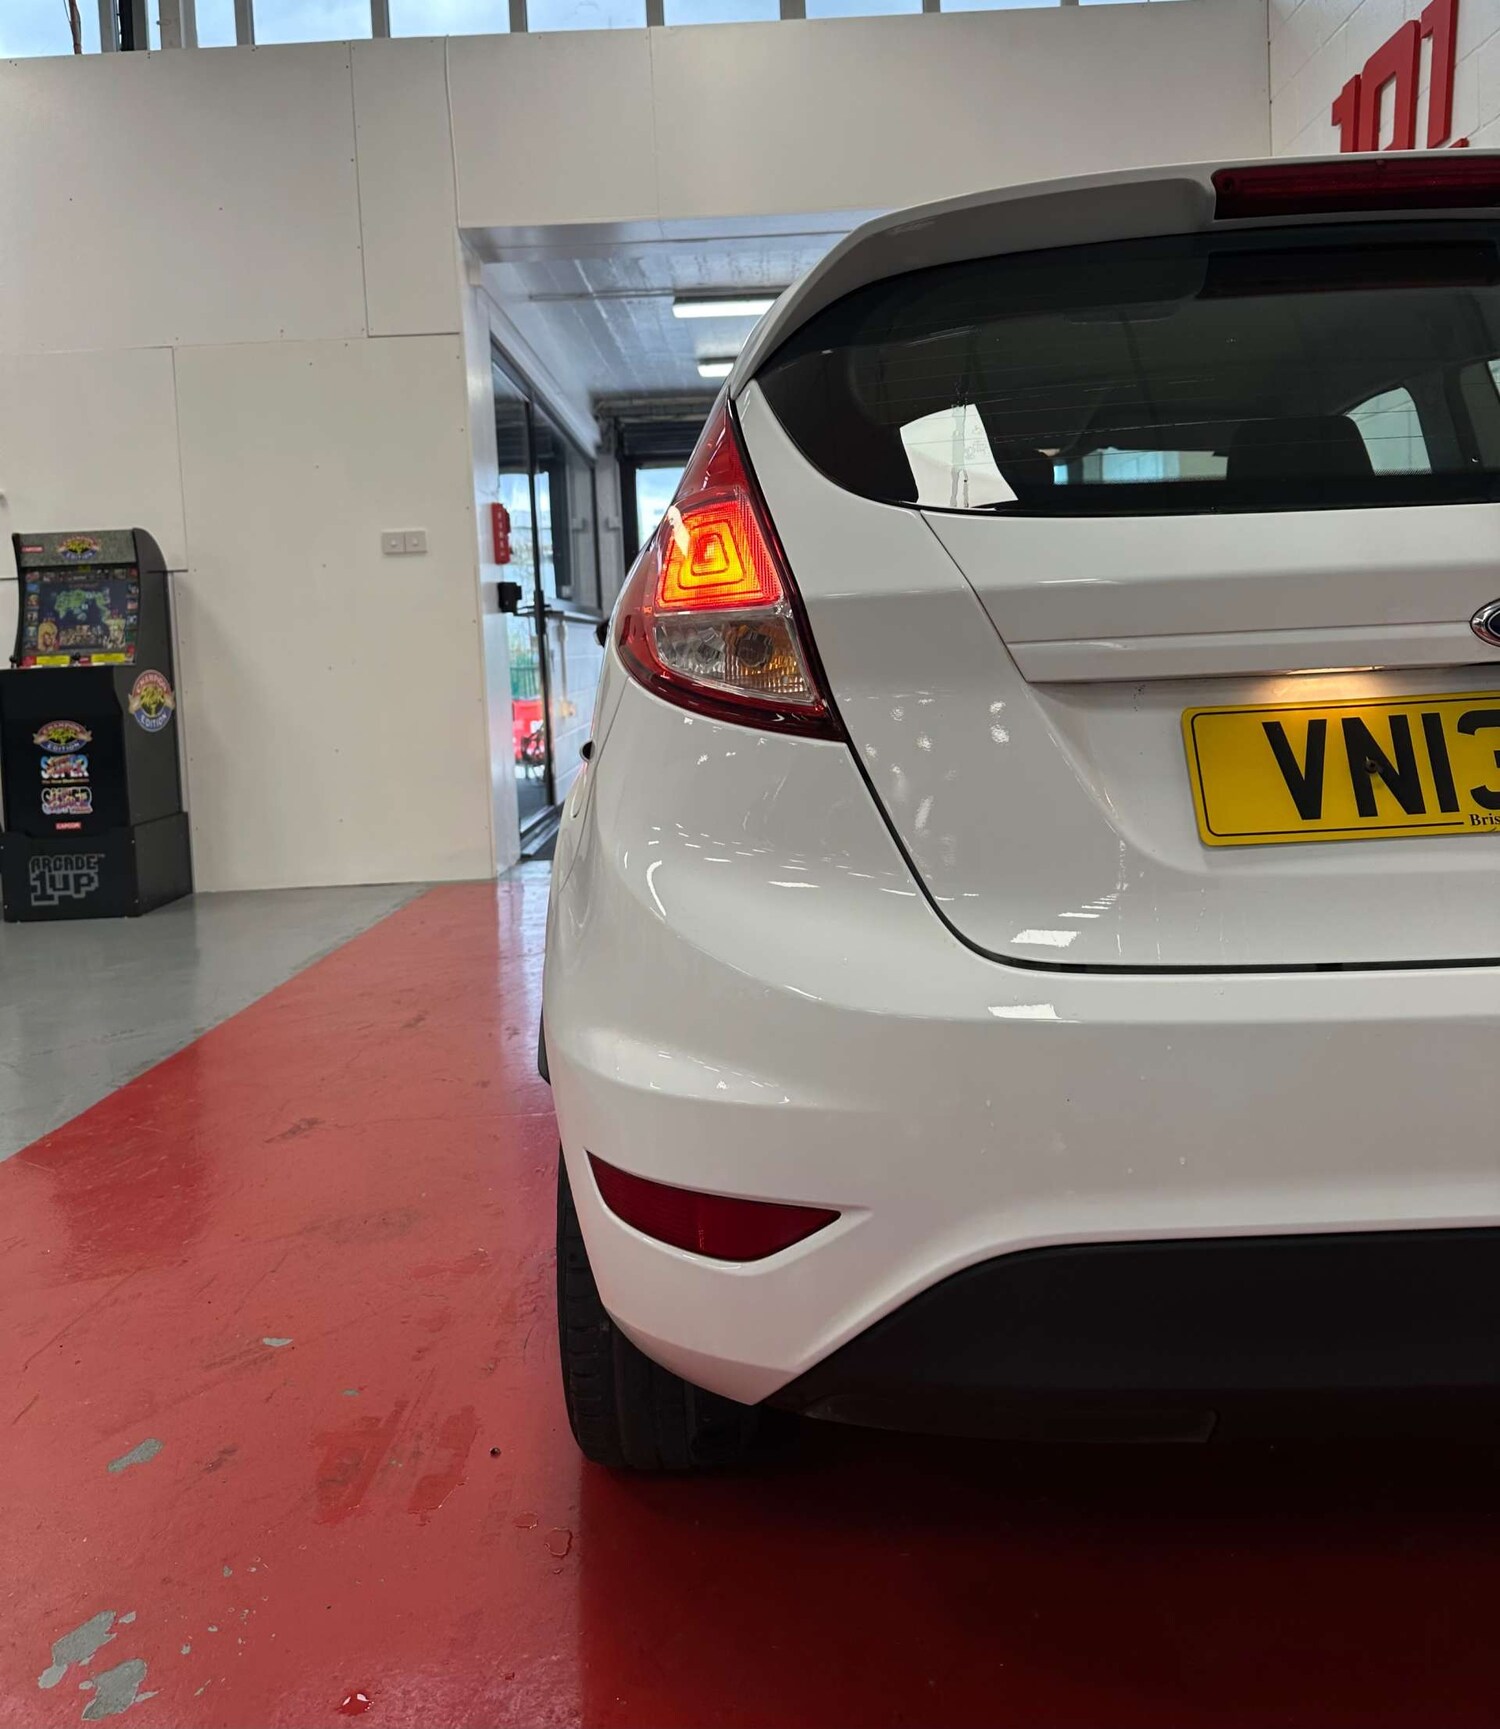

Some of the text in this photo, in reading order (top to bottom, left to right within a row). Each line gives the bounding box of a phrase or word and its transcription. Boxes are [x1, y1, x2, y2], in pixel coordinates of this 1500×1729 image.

[1262, 710, 1500, 820] VN13
[1469, 813, 1500, 826] Bris
[30, 854, 98, 874] ARCADE
